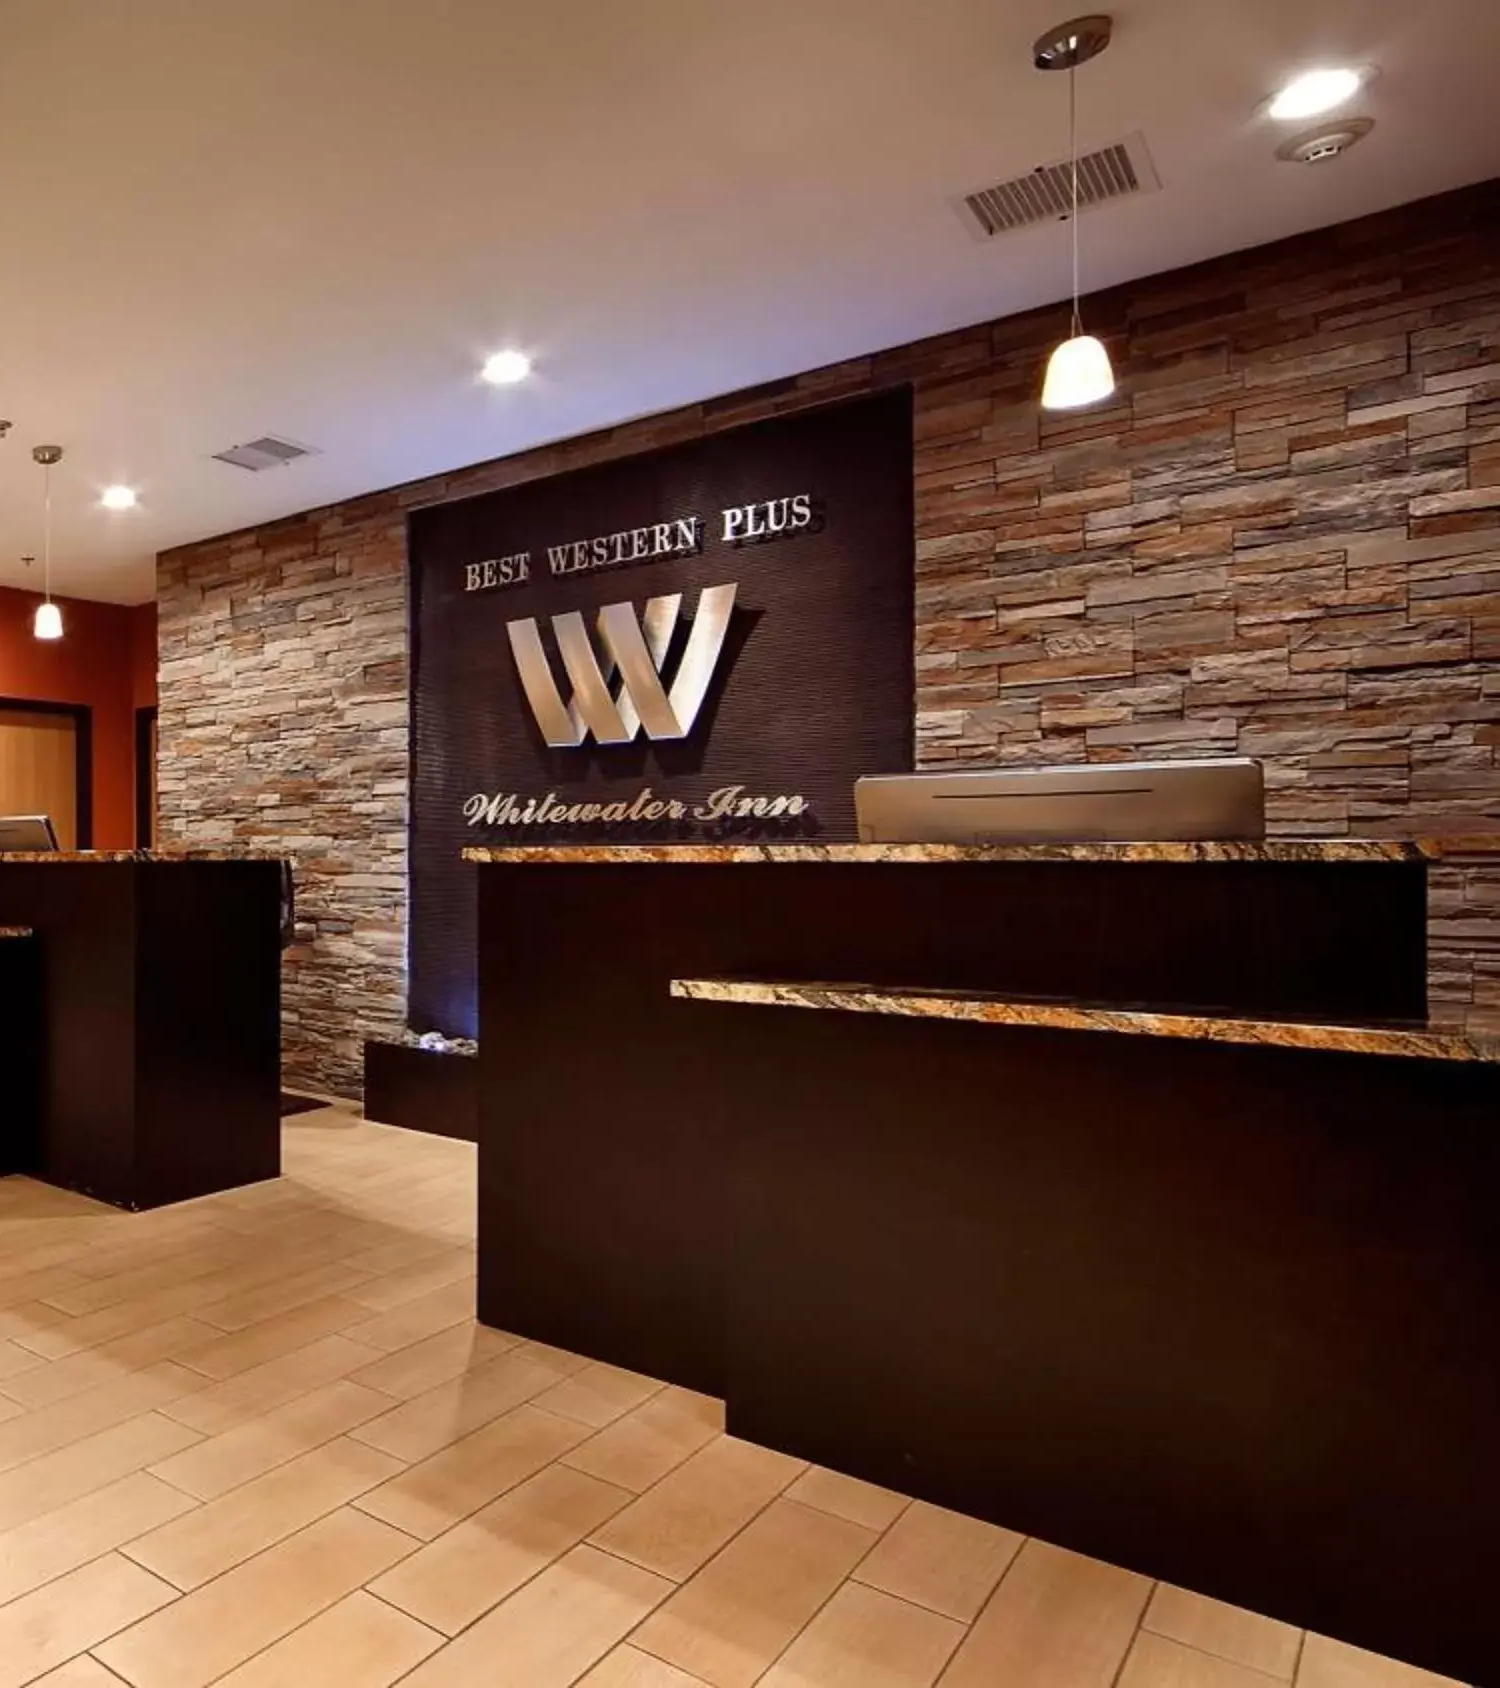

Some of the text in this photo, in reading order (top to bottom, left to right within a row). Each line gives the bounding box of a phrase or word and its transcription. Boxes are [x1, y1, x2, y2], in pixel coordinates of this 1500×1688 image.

[465, 494, 812, 591] BEST WESTERN PLUS
[463, 785, 809, 826] Whitewater Inn
